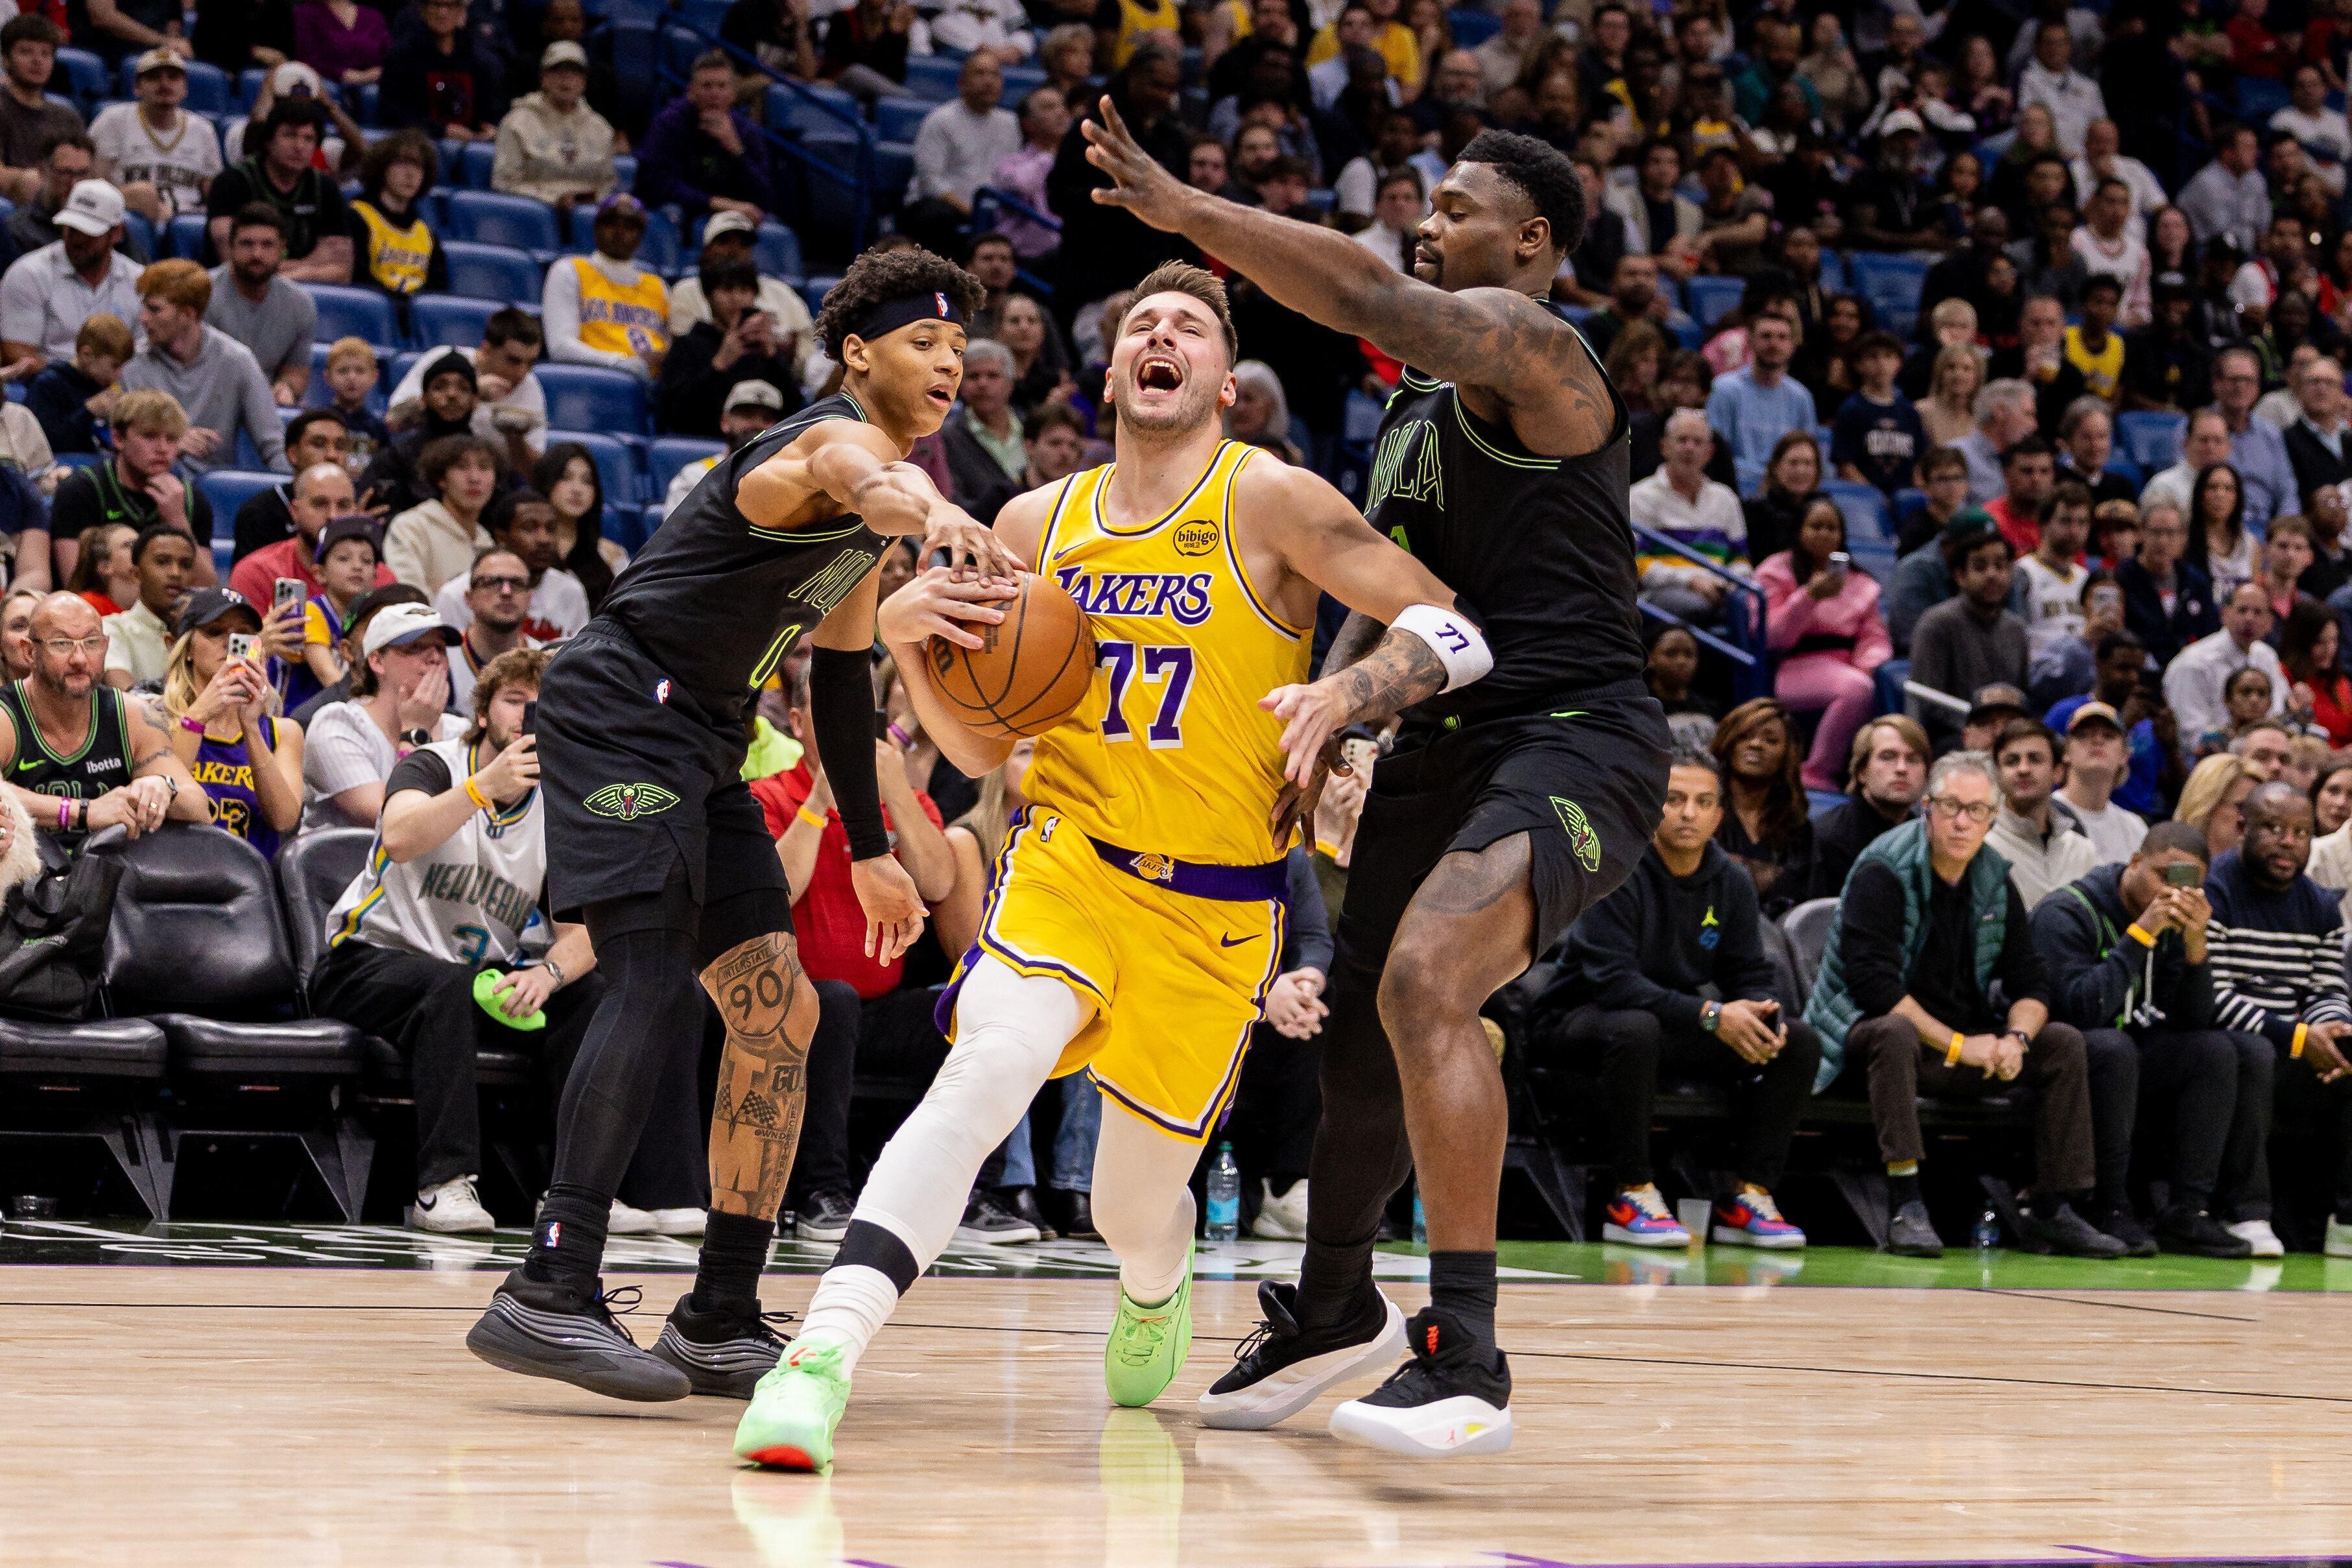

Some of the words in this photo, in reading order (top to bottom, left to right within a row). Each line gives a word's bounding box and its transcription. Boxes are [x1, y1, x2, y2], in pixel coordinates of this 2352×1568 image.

[1178, 529, 1217, 545] bibigo
[1056, 564, 1215, 627] LAKERS
[748, 624, 802, 690] 0
[1434, 622, 1471, 655] 77
[1094, 639, 1197, 750] 77
[85, 757, 122, 774] ibotta
[451, 921, 490, 969] 3
[730, 969, 783, 1022] 90
